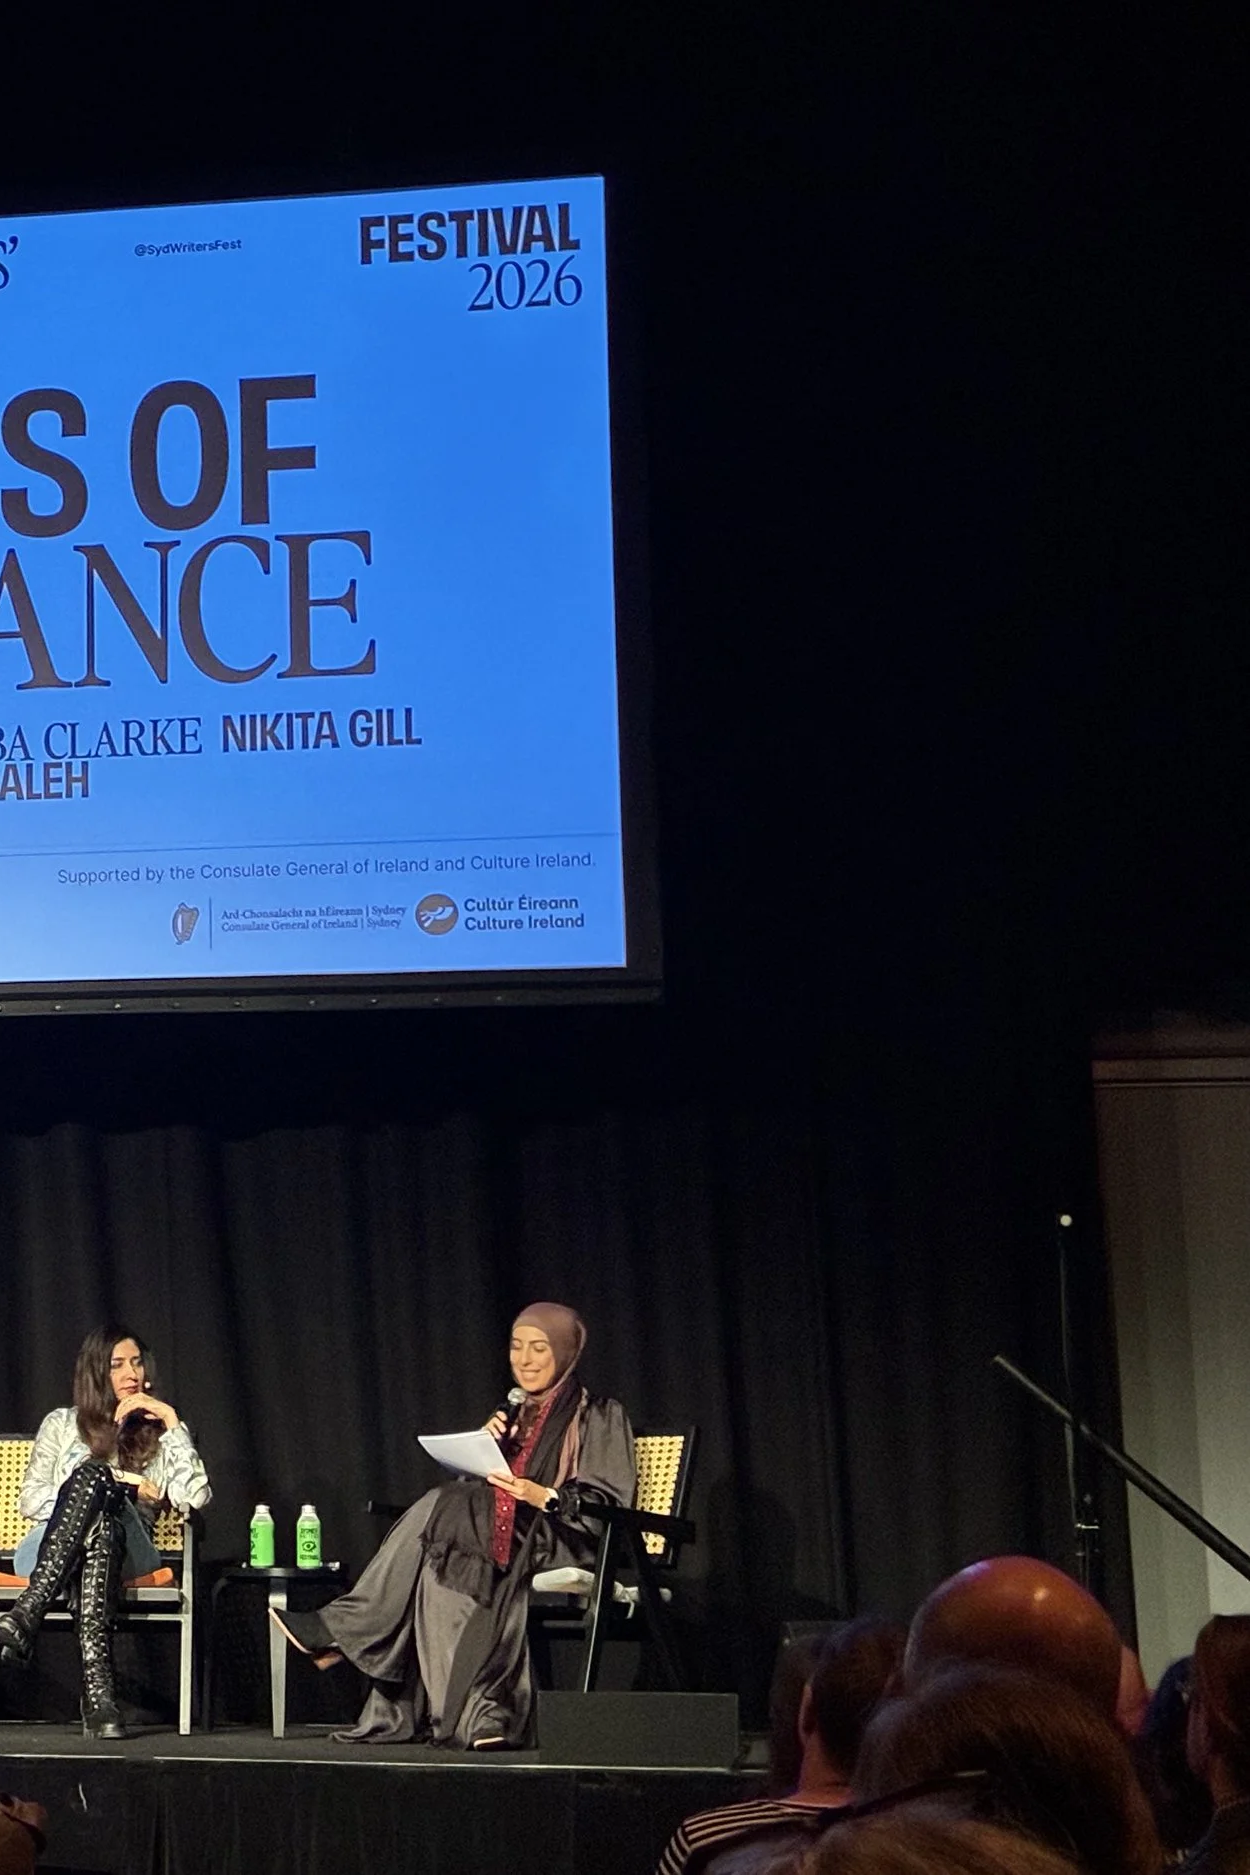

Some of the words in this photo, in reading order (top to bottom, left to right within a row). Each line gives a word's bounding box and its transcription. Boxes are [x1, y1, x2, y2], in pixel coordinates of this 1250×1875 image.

[360, 203, 580, 265] FESTIVAL
[134, 239, 242, 257] @SydWritersFest
[467, 256, 583, 312] 2026
[129, 374, 317, 531] OF
[44, 717, 203, 760] CLARKE
[222, 711, 340, 752] NIKITA
[349, 707, 423, 747] GILL
[57, 867, 140, 887] Supported
[146, 867, 164, 884] by
[170, 866, 195, 880] the
[200, 862, 281, 879] Consulate
[286, 859, 348, 876] General
[353, 859, 369, 874] of
[375, 858, 429, 873] Ireland
[434, 856, 465, 872] and
[471, 854, 530, 871] Culture
[536, 852, 596, 868] Ireland.
[304, 909, 317, 918] na
[371, 905, 407, 918] Sydney
[464, 897, 513, 912] Cultúr
[518, 893, 579, 911] Éireann
[221, 921, 270, 932] Consulate
[272, 919, 309, 931] General
[312, 918, 323, 929] of
[323, 918, 358, 929] Ireland
[367, 918, 401, 930] Sydney
[464, 916, 523, 931] Culture
[528, 913, 585, 929] Ireland
